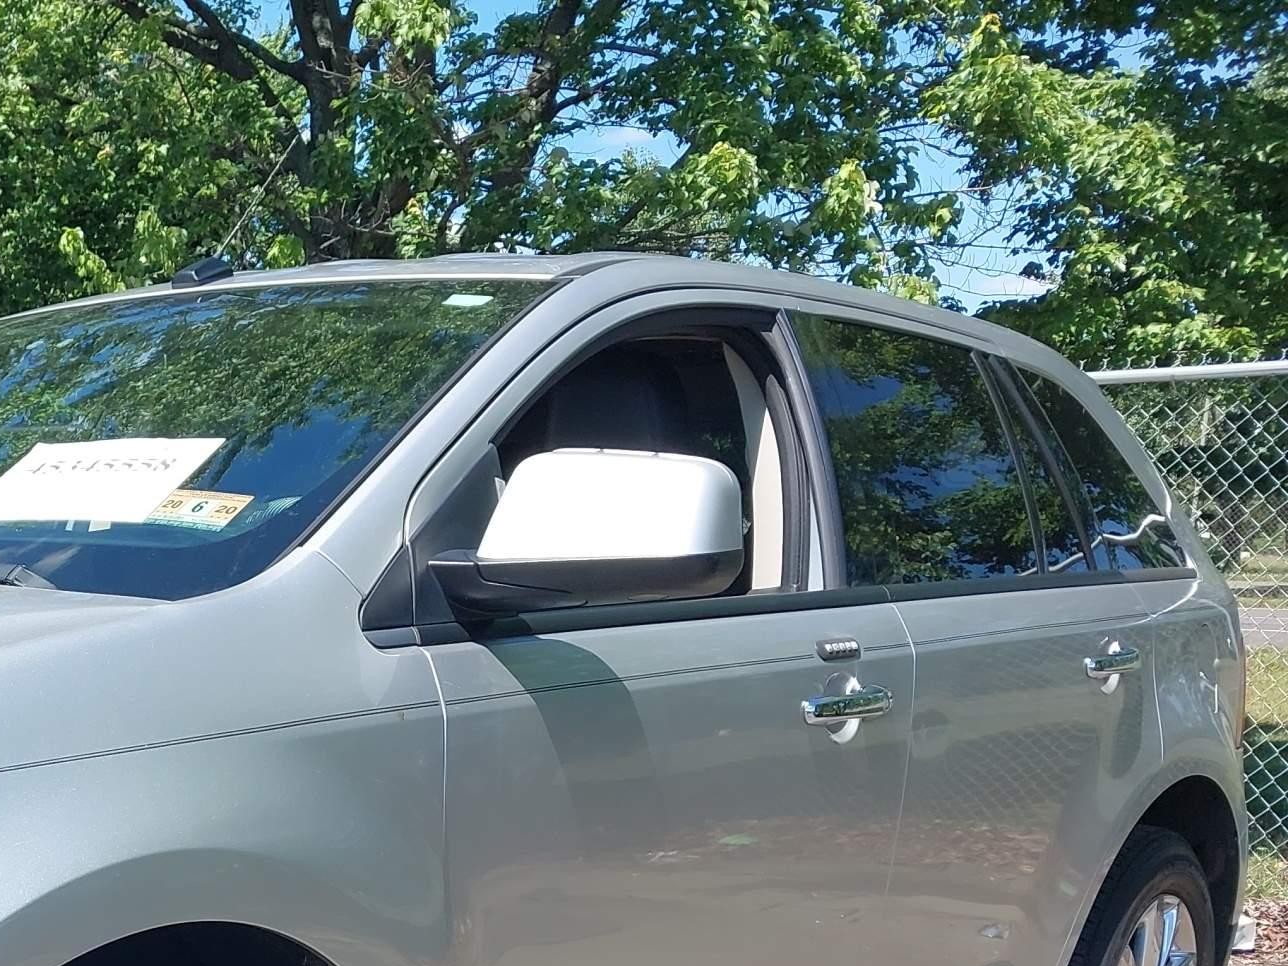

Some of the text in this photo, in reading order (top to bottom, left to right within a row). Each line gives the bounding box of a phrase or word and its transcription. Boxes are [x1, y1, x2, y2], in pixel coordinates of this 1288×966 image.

[160, 499, 239, 515] 20 6 20
